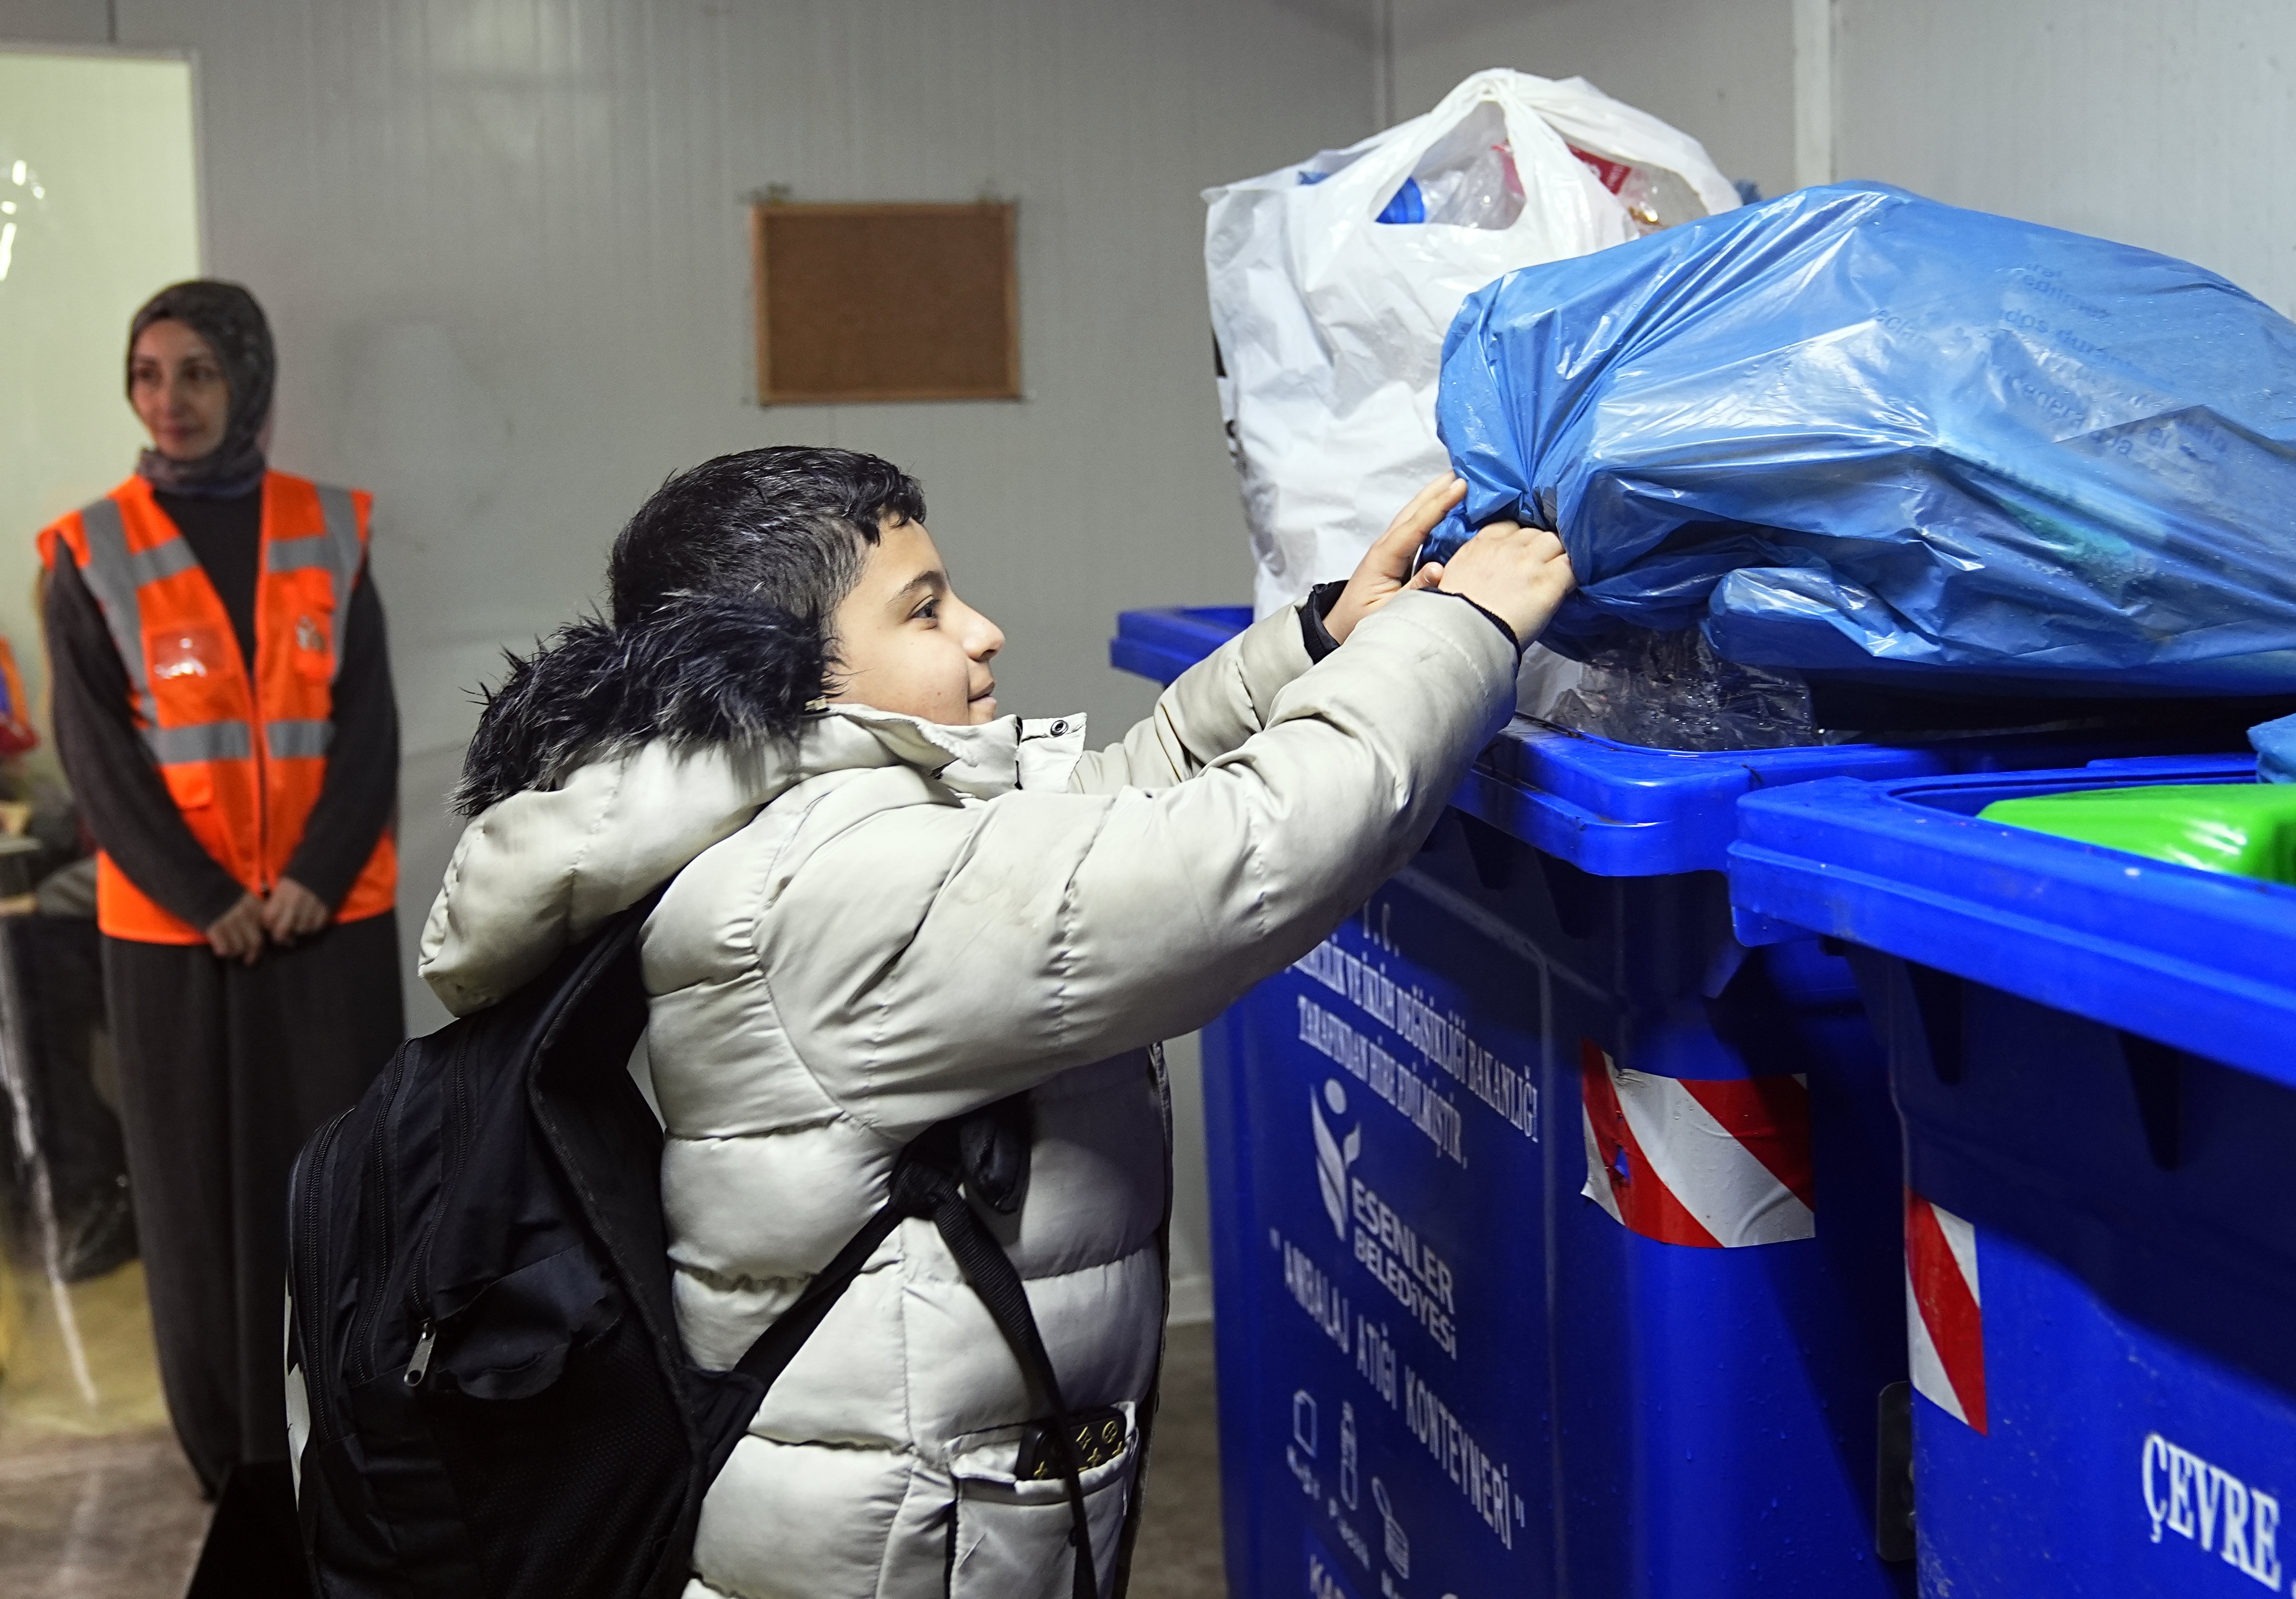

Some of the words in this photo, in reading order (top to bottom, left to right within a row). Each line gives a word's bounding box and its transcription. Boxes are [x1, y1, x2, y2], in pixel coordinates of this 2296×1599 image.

[1351, 1176, 1455, 1315] ESENLER
[1354, 1225, 1457, 1361] BELEDİYESİ
[2142, 1430, 2282, 1593] ÇEVRE
